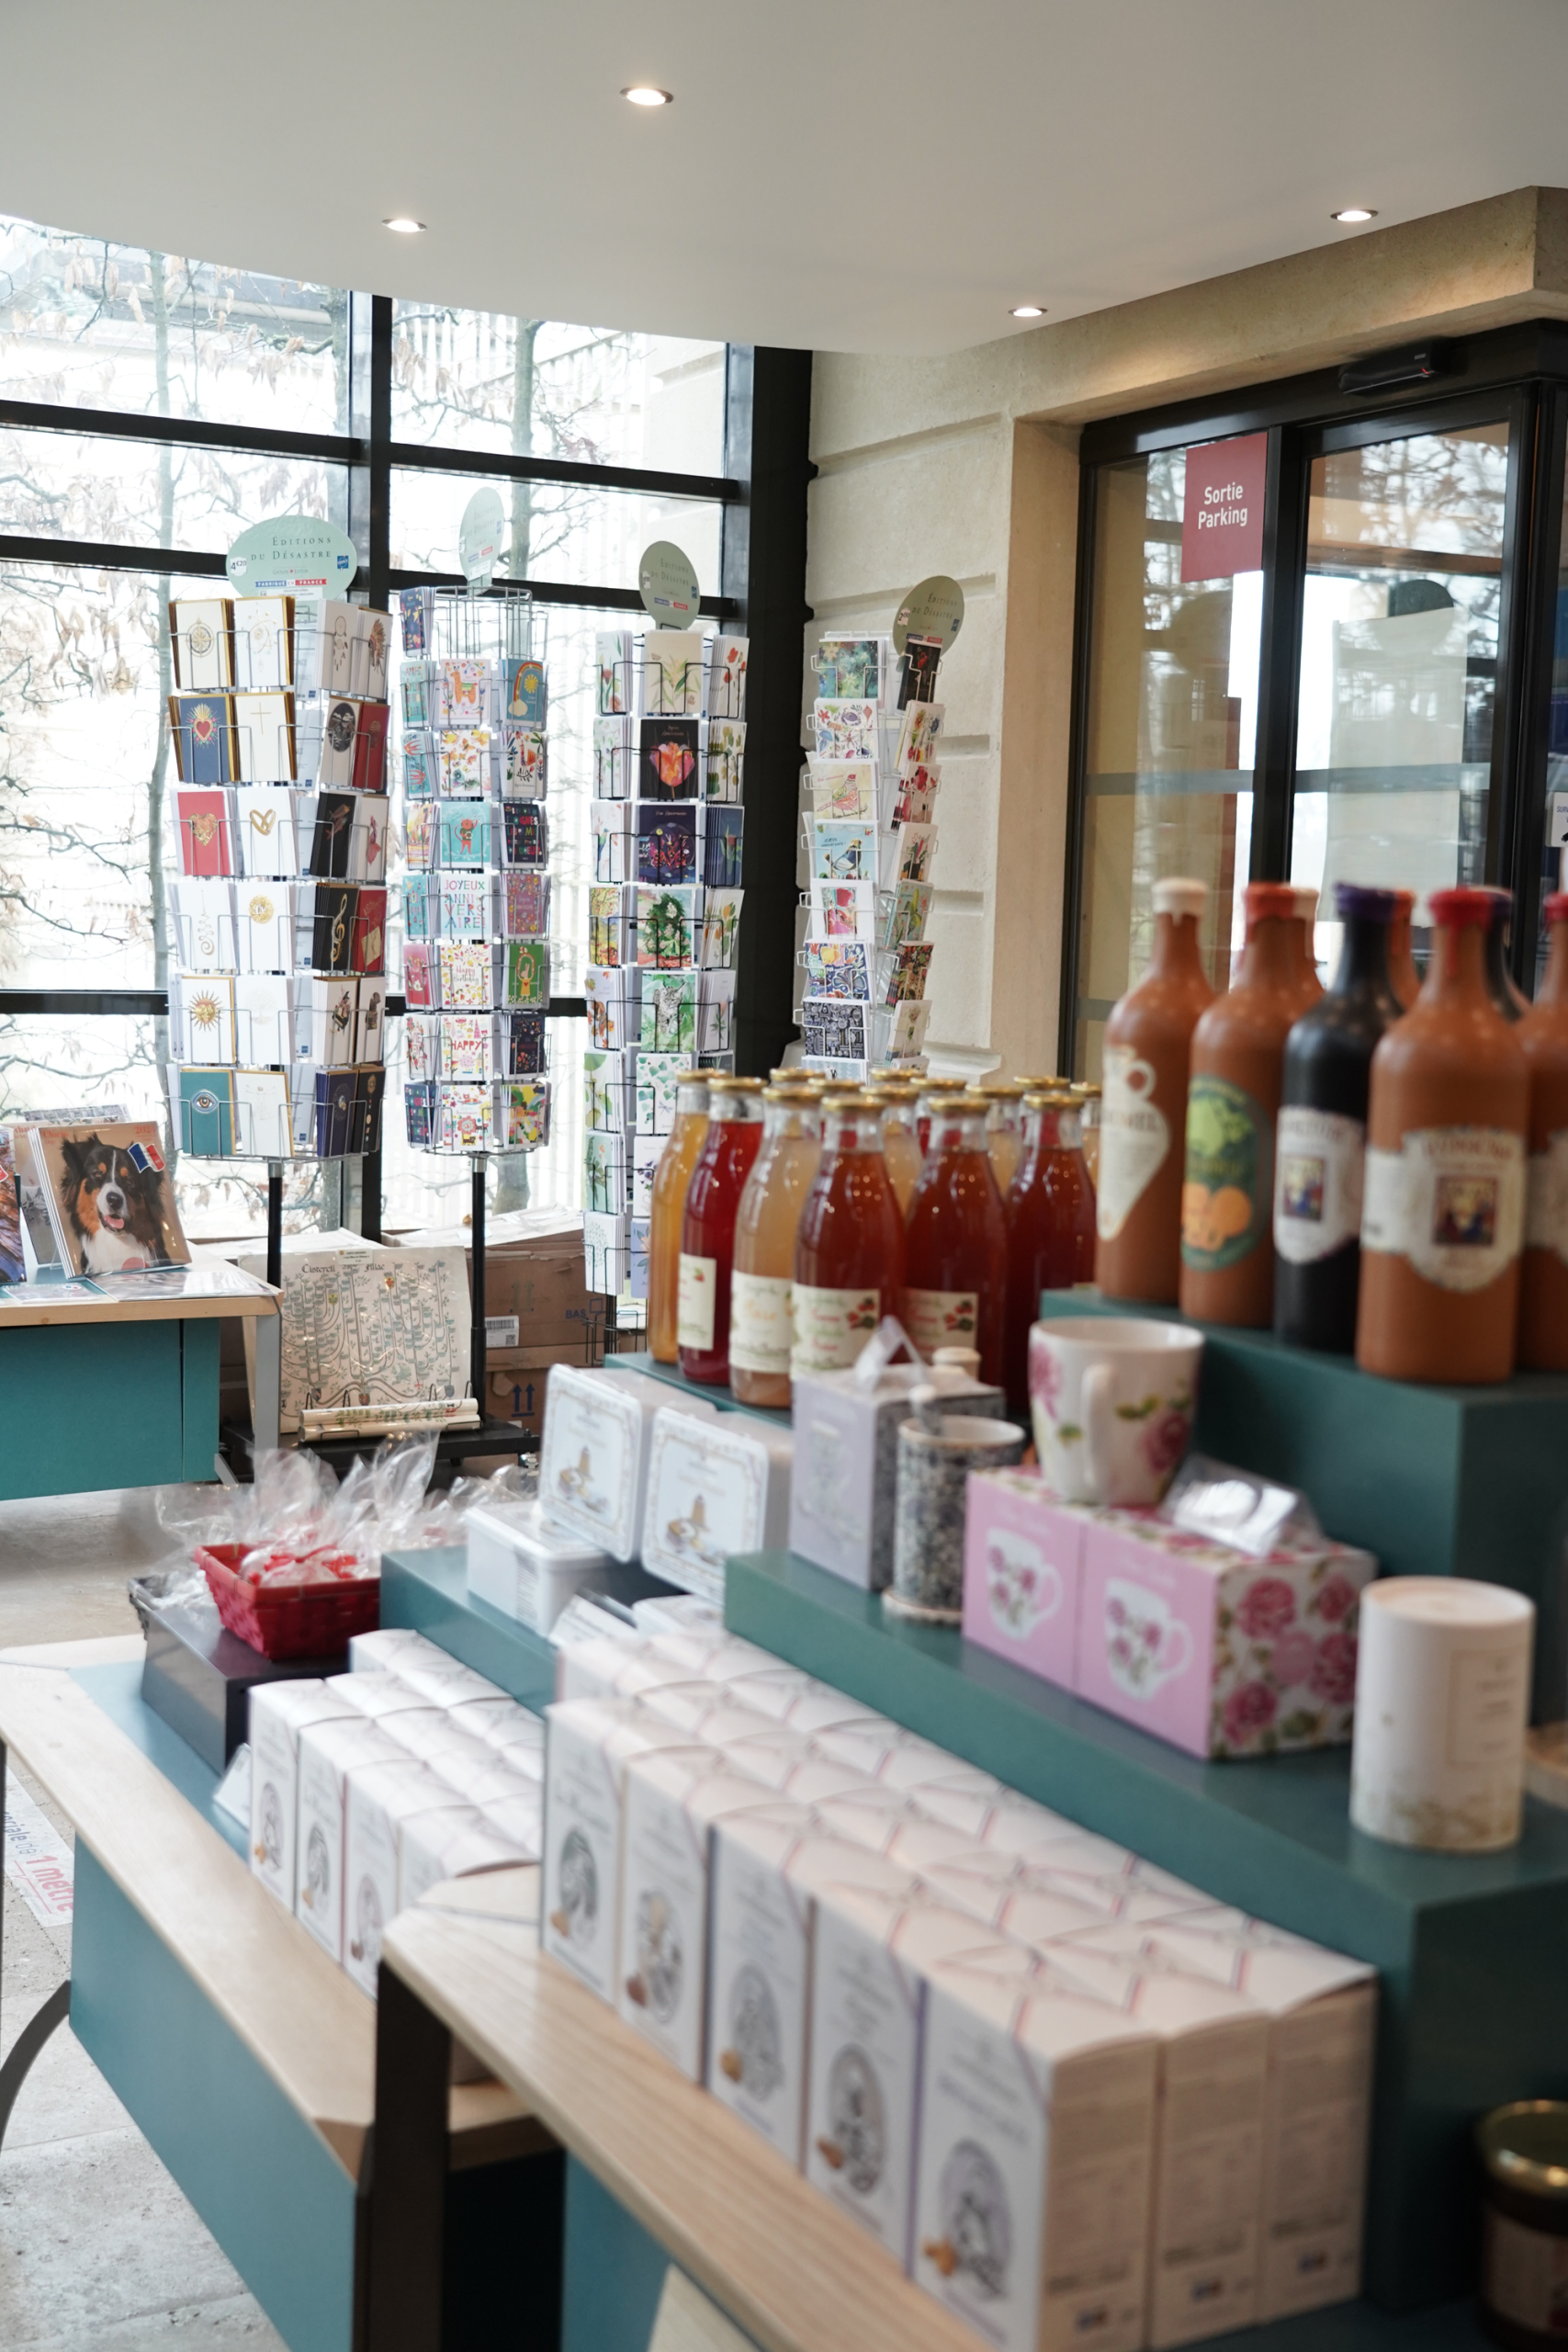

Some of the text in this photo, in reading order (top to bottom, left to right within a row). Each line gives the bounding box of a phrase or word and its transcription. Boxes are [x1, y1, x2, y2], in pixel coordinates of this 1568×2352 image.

[1204, 482, 1244, 504] Sortie
[1198, 506, 1247, 529] Parking
[445, 879, 485, 890] JOYEUX
[445, 903, 485, 917] VERS
[456, 965, 476, 978] Happy
[453, 974, 479, 985] Birthday
[452, 1040, 481, 1050] HAPPY
[566, 1308, 586, 1319] BAS
